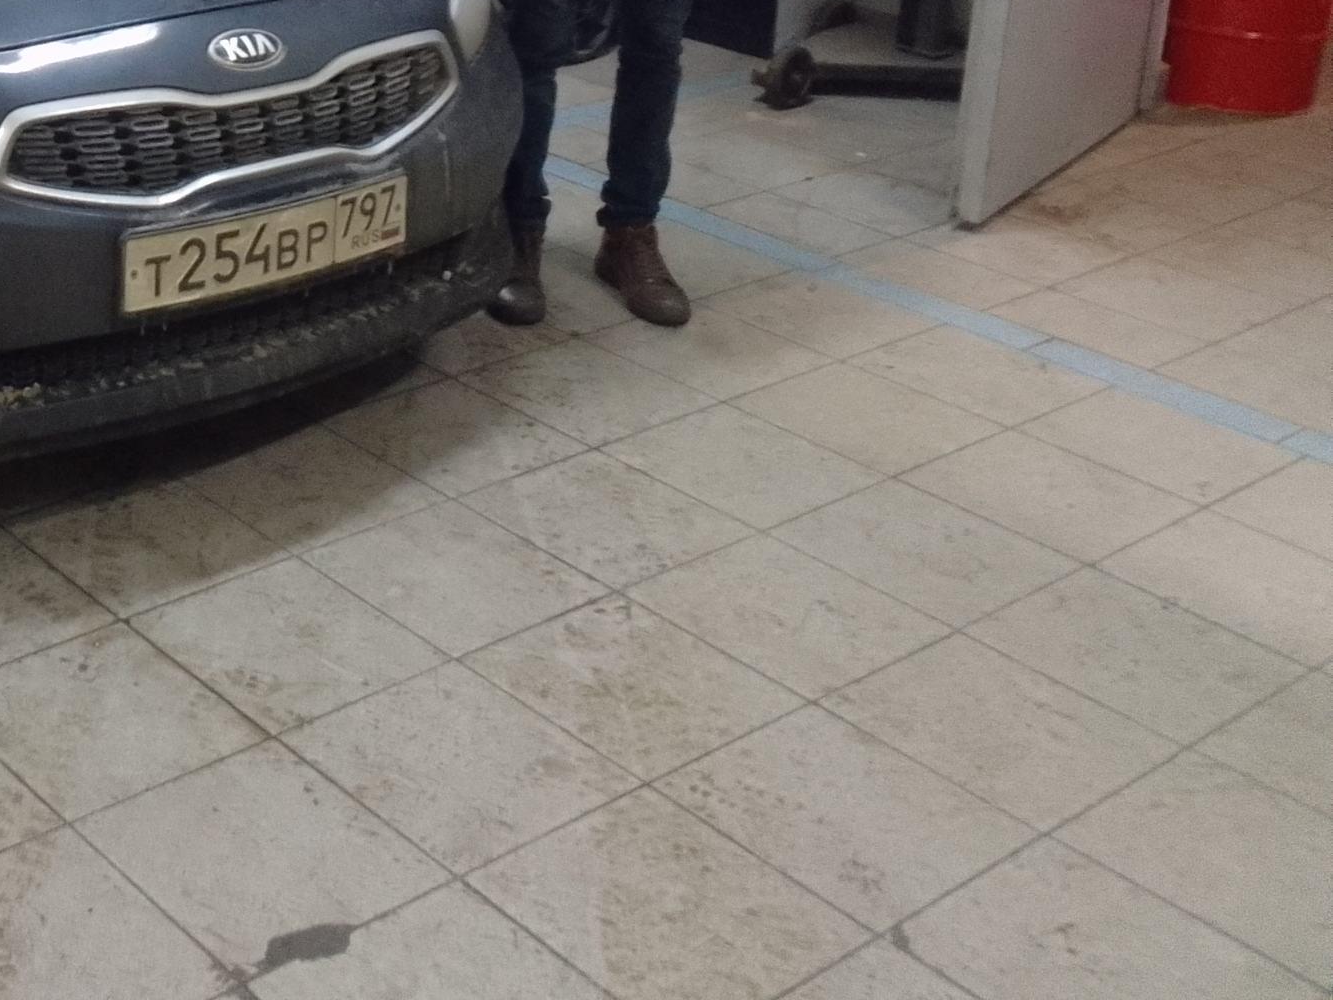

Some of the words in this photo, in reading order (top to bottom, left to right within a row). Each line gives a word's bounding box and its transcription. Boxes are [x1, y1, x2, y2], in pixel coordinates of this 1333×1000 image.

[218, 33, 276, 62] KIA
[144, 221, 328, 297] Т254ВР
[339, 184, 396, 239] 797
[351, 229, 380, 249] RUS
